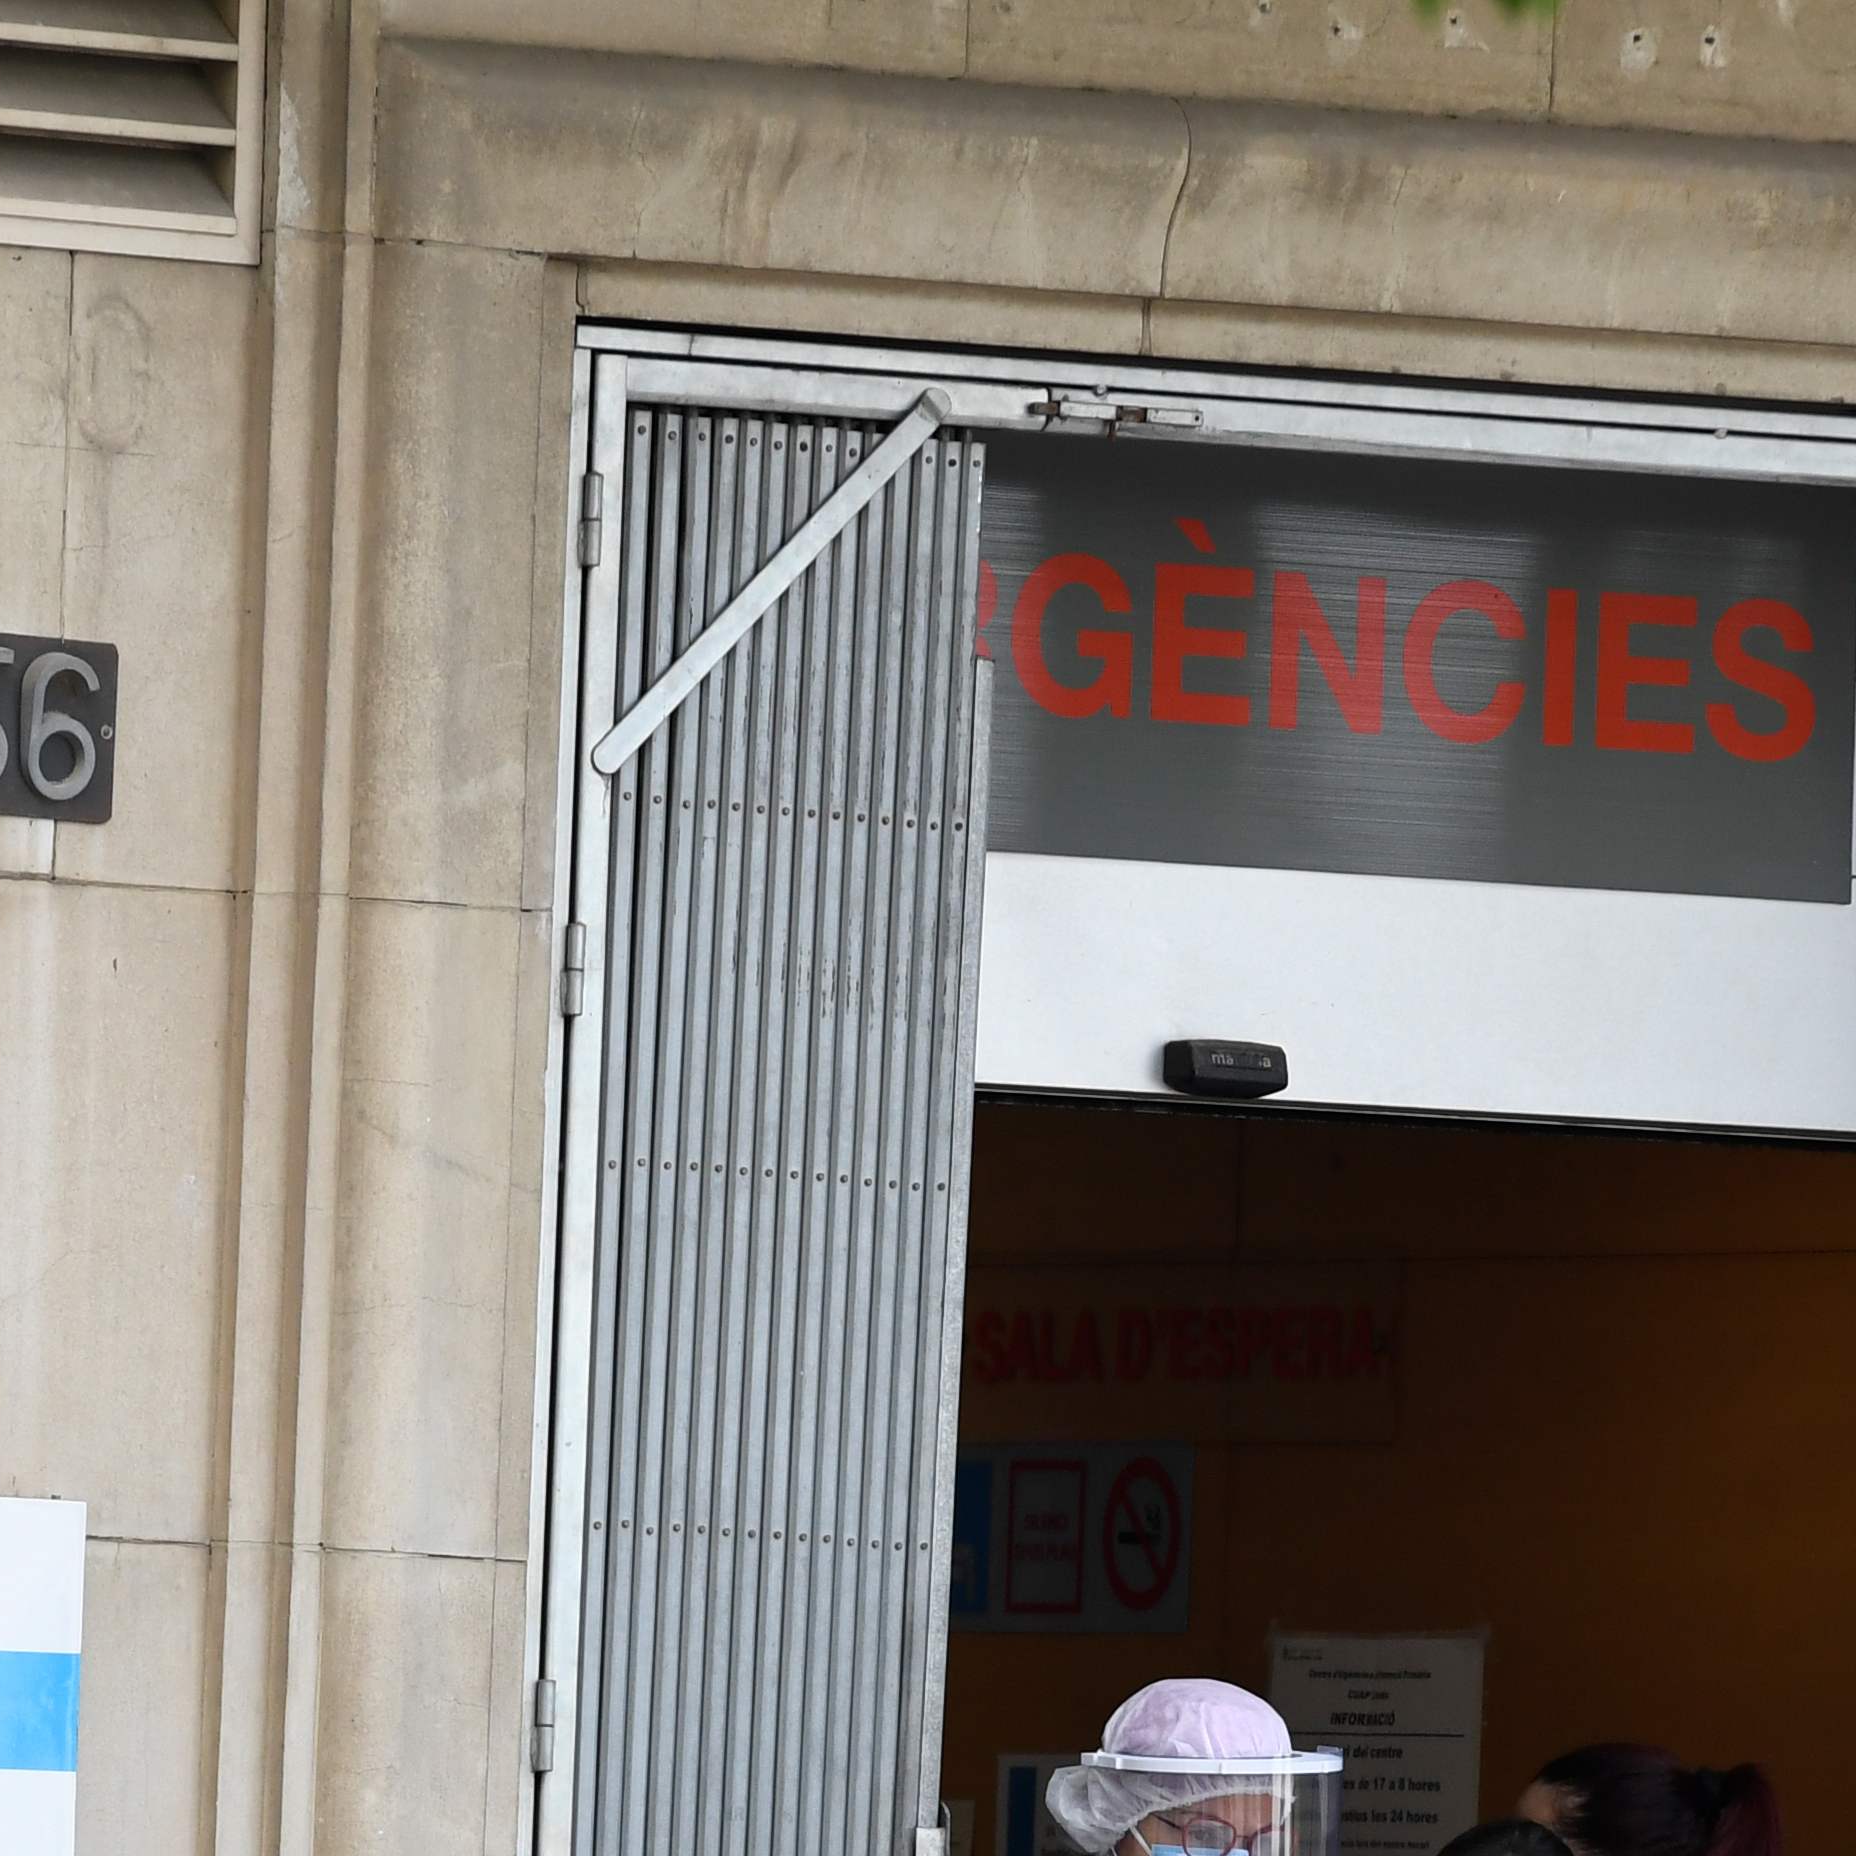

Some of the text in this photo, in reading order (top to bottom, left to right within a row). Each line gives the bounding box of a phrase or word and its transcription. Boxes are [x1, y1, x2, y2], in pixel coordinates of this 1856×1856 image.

[976, 516, 1817, 763] GÈNCIES
[973, 1307, 1103, 1386] SALA
[1373, 1777, 1386, 1791] 17
[1407, 1778, 1441, 1793] hores
[1390, 1809, 1403, 1824] 24
[1406, 1809, 1439, 1825] hores
